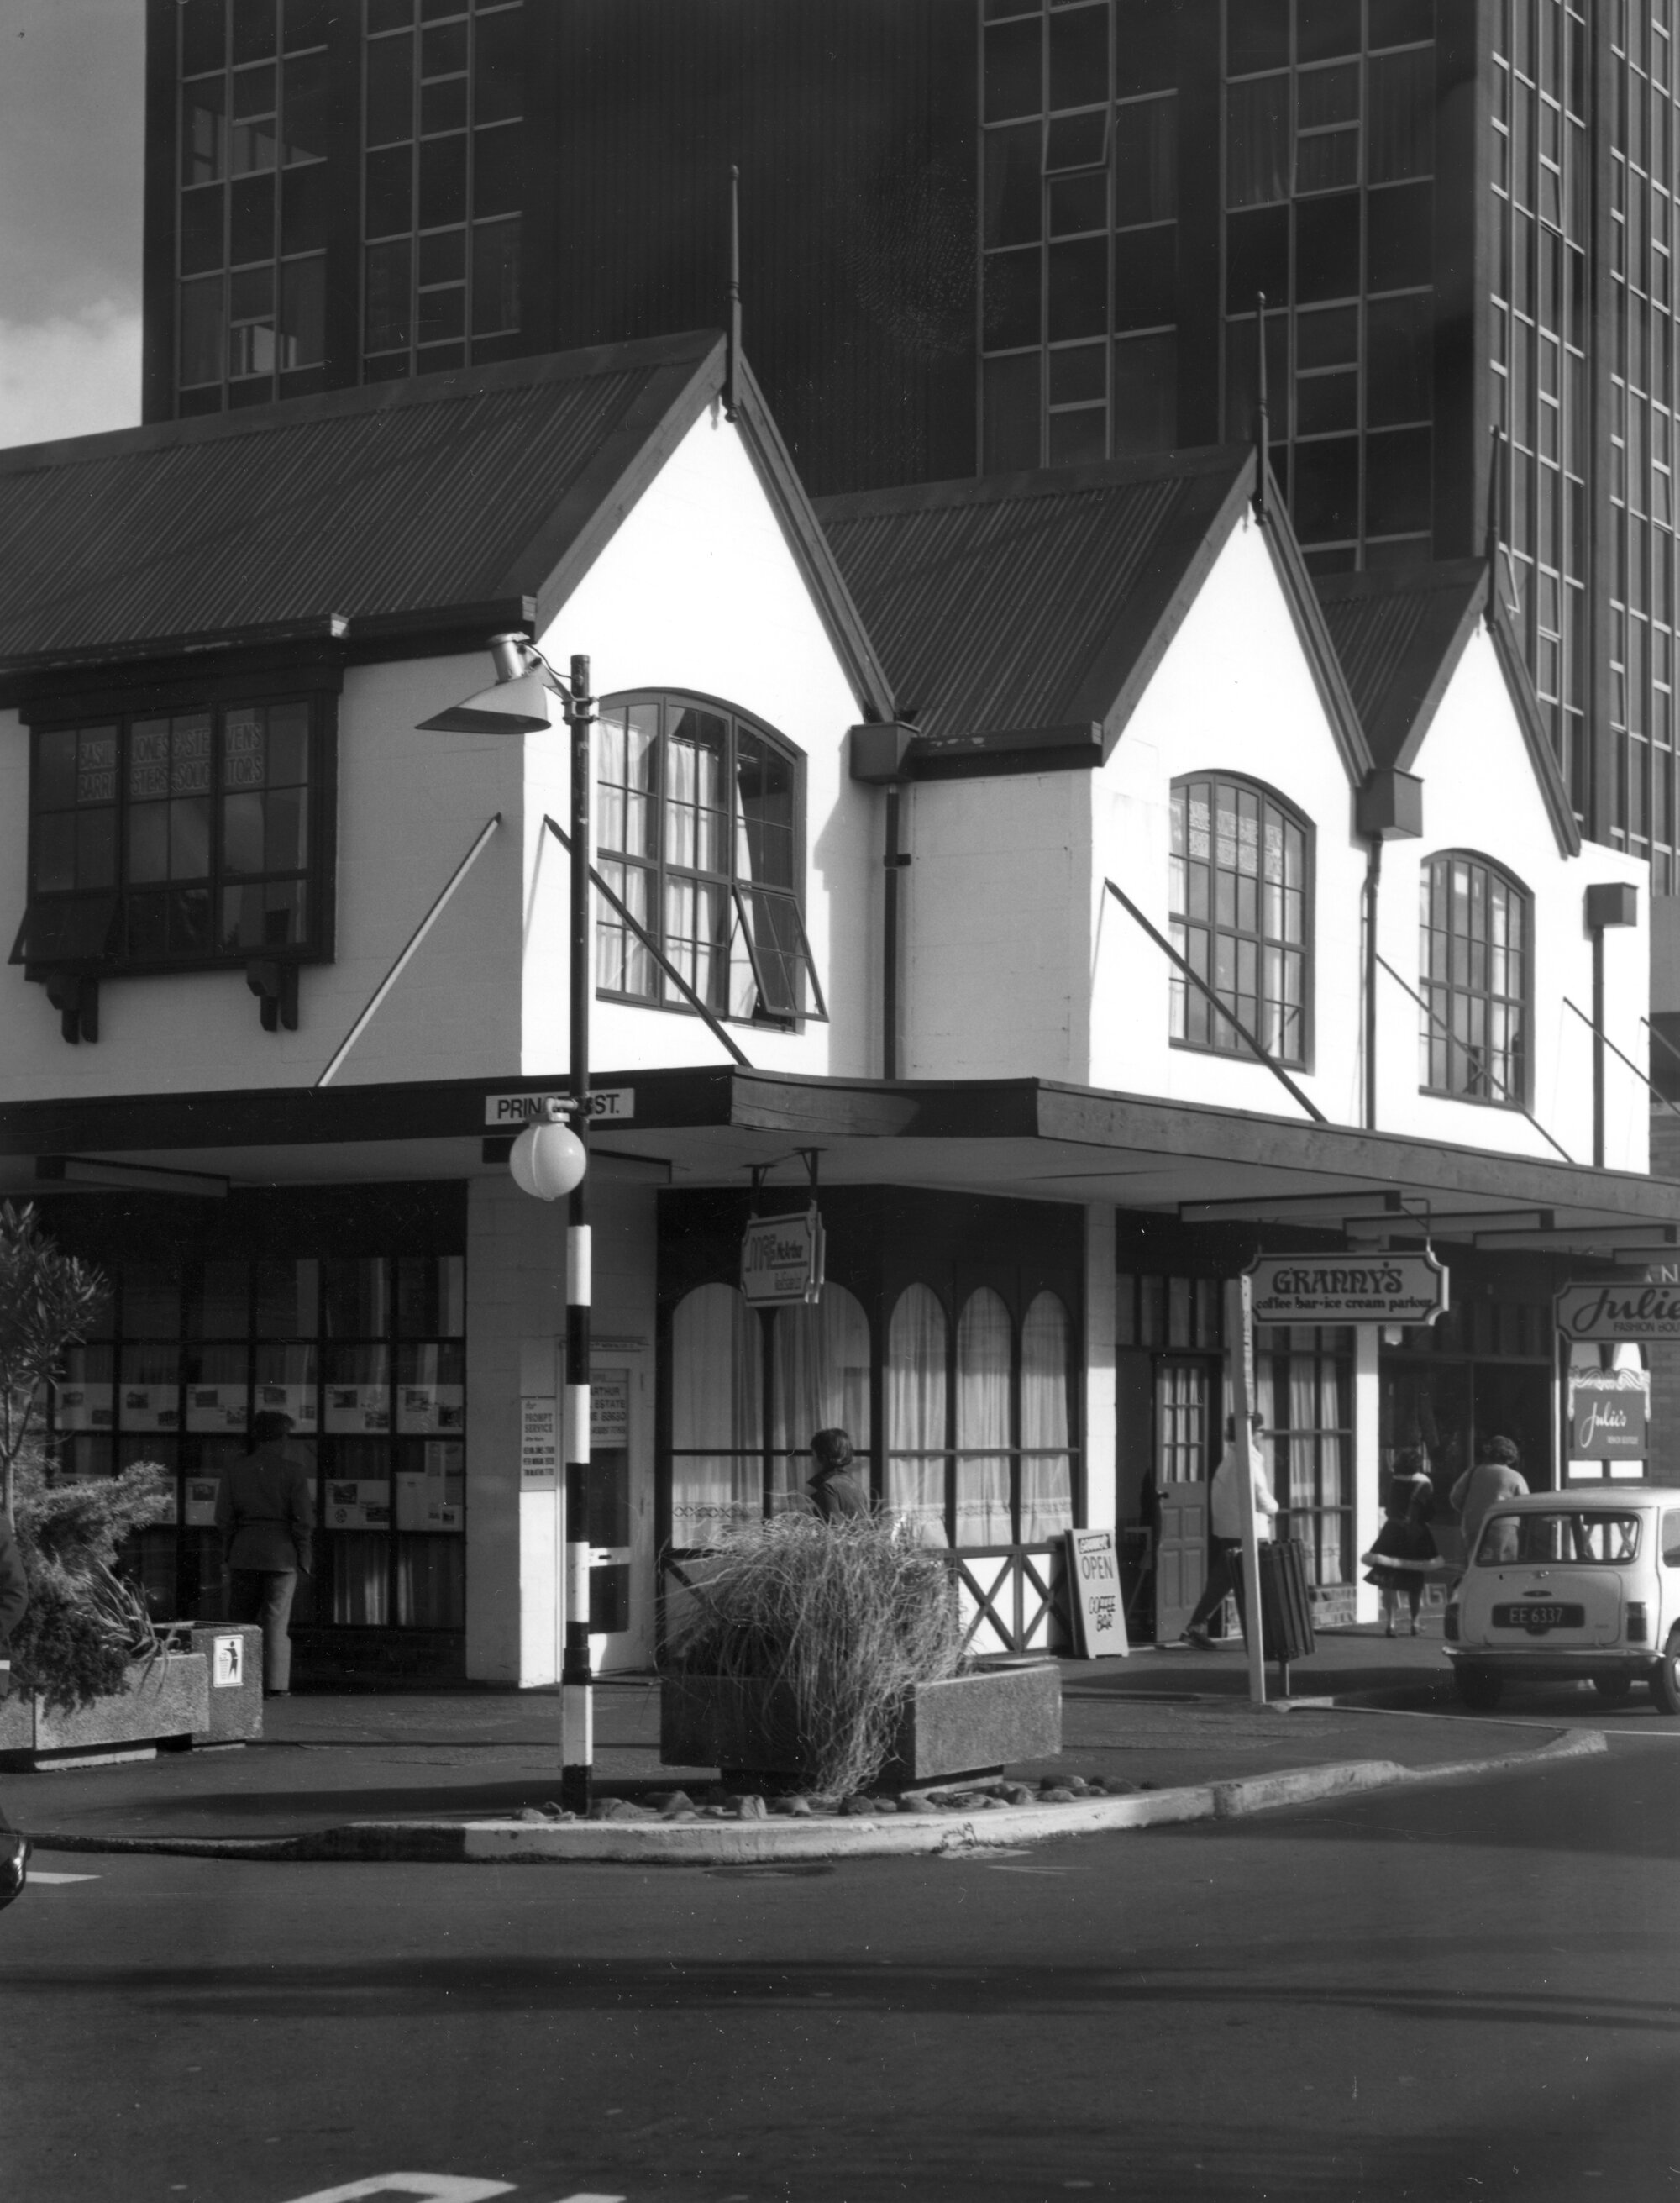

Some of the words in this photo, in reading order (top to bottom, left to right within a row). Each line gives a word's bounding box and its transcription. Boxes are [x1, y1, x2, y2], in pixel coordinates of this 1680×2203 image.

[79, 742, 116, 769] BASIL
[133, 733, 170, 763] JONES
[596, 1094, 620, 1114] ST.
[1273, 1262, 1403, 1295] GRANNY'S
[1256, 1297, 1291, 1310] coffee
[1345, 1299, 1385, 1309] cream
[1389, 1296, 1433, 1312] parlour
[1614, 1322, 1655, 1332] FASHION
[595, 1399, 626, 1409] ESTATE
[525, 1412, 553, 1422] PROMPT
[525, 1423, 553, 1433] SERVICE
[1082, 1556, 1113, 1580] OPEN
[1089, 1595, 1116, 1615] COFFEE
[1096, 1612, 1113, 1633] BAR
[1509, 1607, 1527, 1624] EE
[1531, 1607, 1562, 1624] 6337
